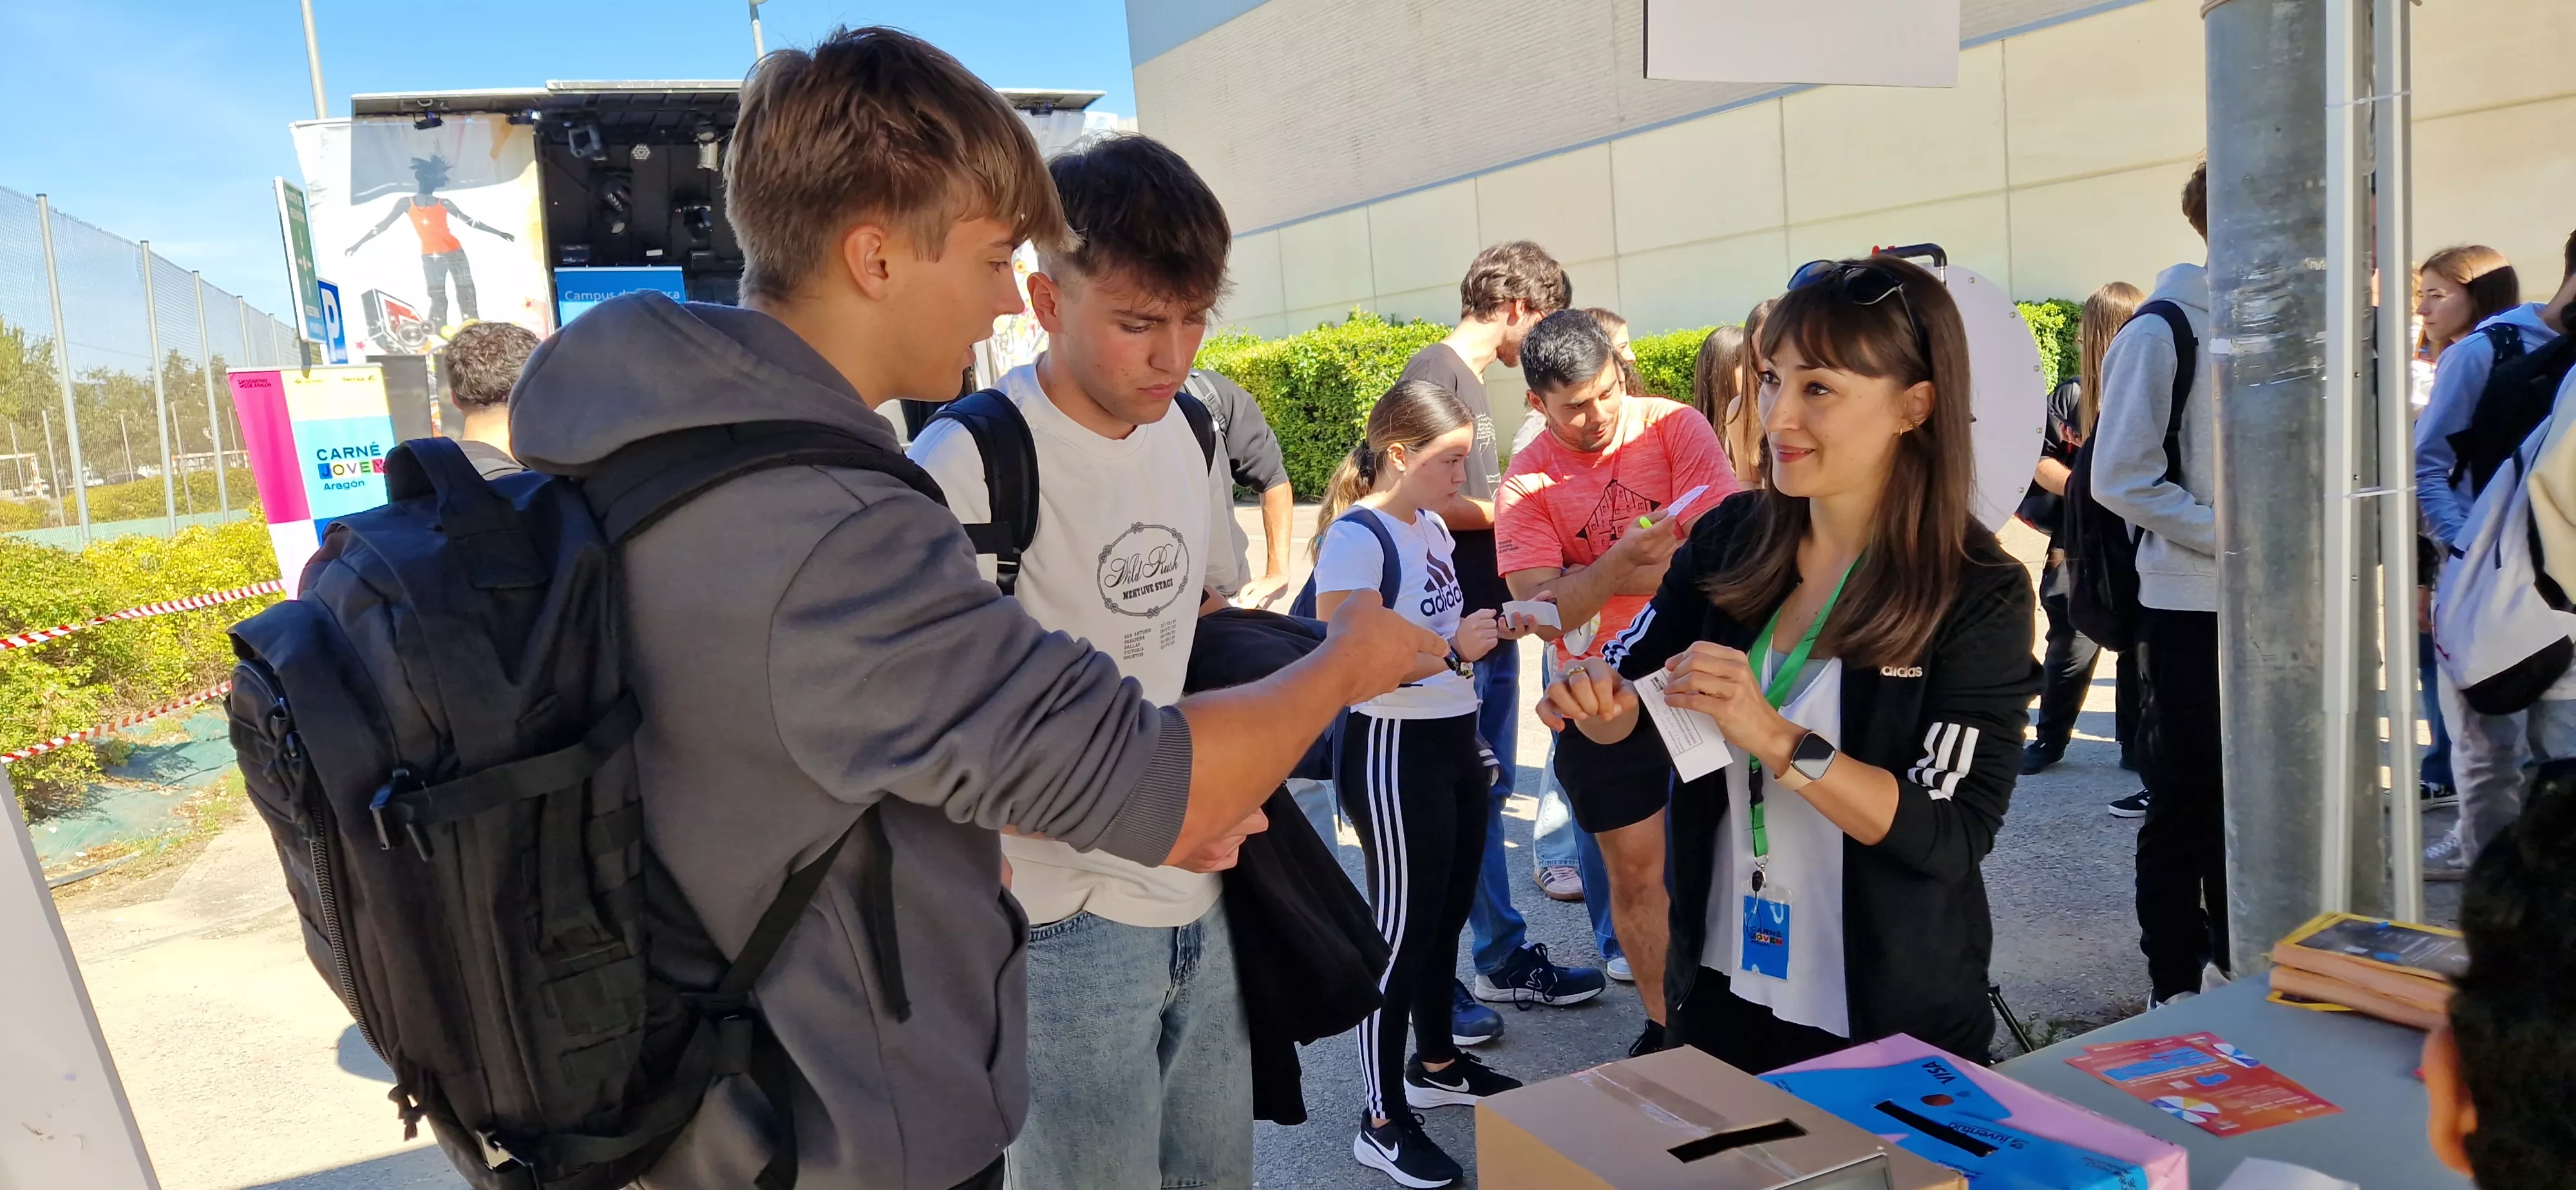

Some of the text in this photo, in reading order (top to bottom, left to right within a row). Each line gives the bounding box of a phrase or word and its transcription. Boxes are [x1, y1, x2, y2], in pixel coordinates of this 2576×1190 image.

[565, 290, 616, 303] Campus
[321, 287, 340, 362] P
[316, 441, 381, 460] CARNÉ
[324, 480, 365, 490] Aragón
[1104, 543, 1182, 588] Wild Rush
[1141, 583, 1154, 596] LIVE
[1420, 584, 1463, 617] adida
[1880, 666, 1923, 678] didas
[1921, 1061, 1956, 1086] VISA
